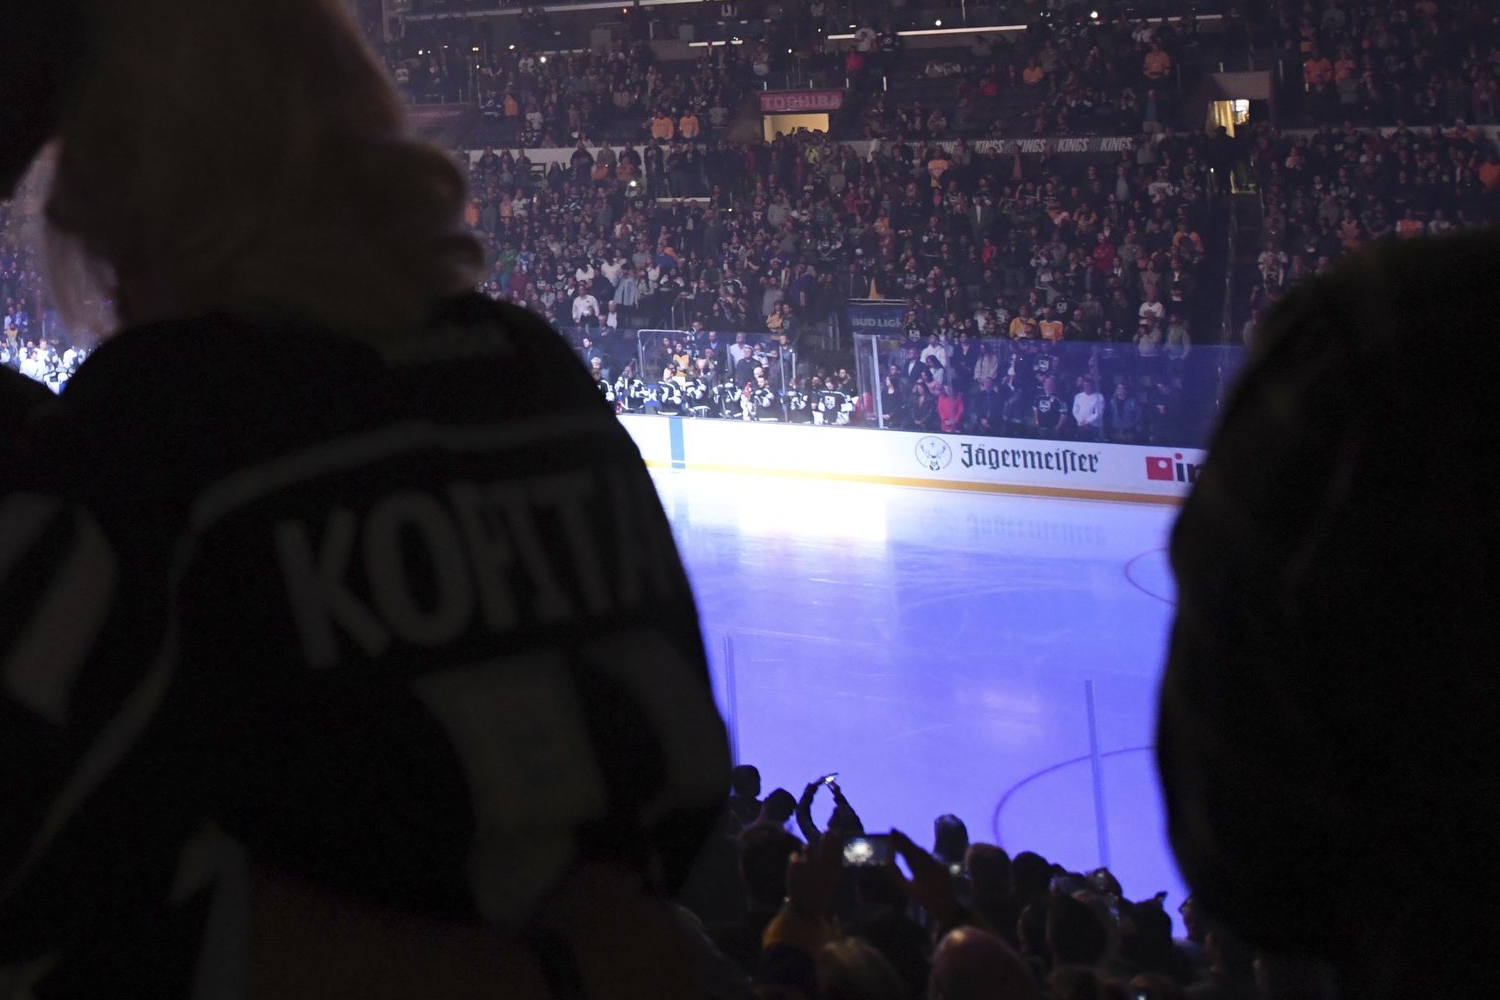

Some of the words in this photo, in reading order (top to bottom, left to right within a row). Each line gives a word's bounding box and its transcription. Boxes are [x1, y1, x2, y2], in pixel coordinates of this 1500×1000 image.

[765, 94, 843, 109] TOSHIBA
[1058, 138, 1089, 152] KINGS
[1100, 136, 1133, 152] KINGS
[852, 318, 876, 327] BUD
[960, 442, 1099, 474] Jägermeister
